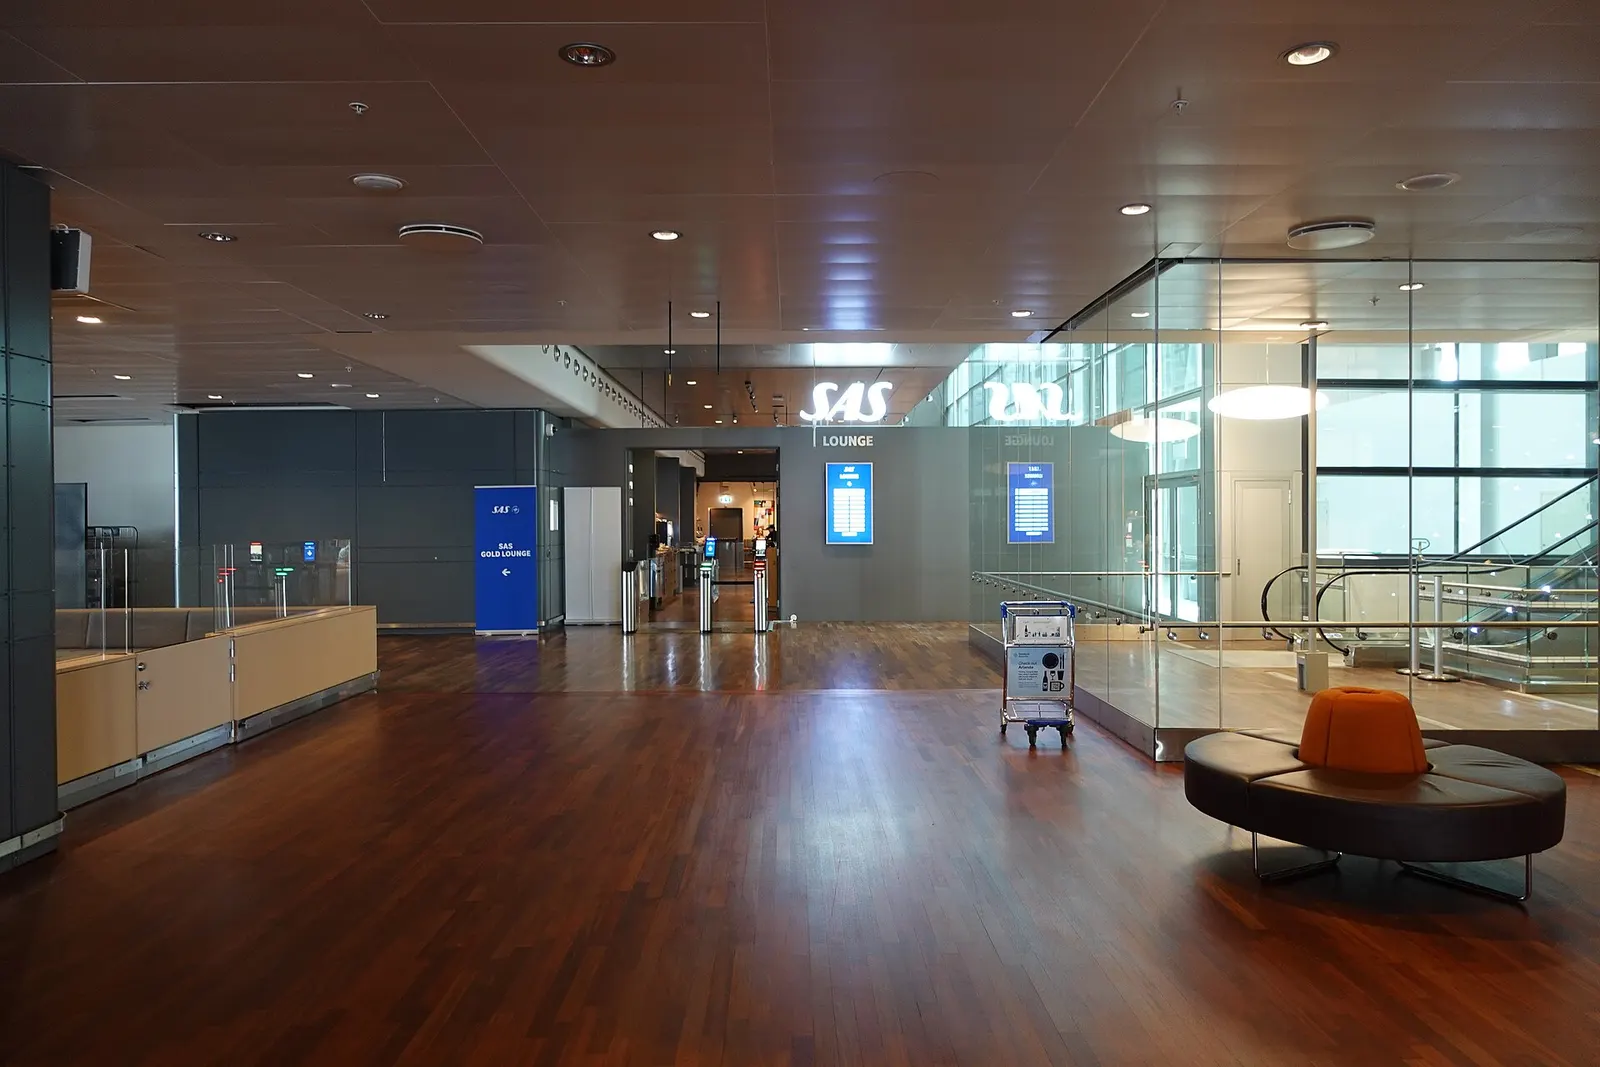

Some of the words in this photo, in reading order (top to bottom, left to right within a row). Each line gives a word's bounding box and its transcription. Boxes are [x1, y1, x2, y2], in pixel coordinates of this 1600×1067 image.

[799, 381, 893, 422] SAS
[822, 435, 874, 447] LOUNGE
[492, 505, 511, 514] SAS
